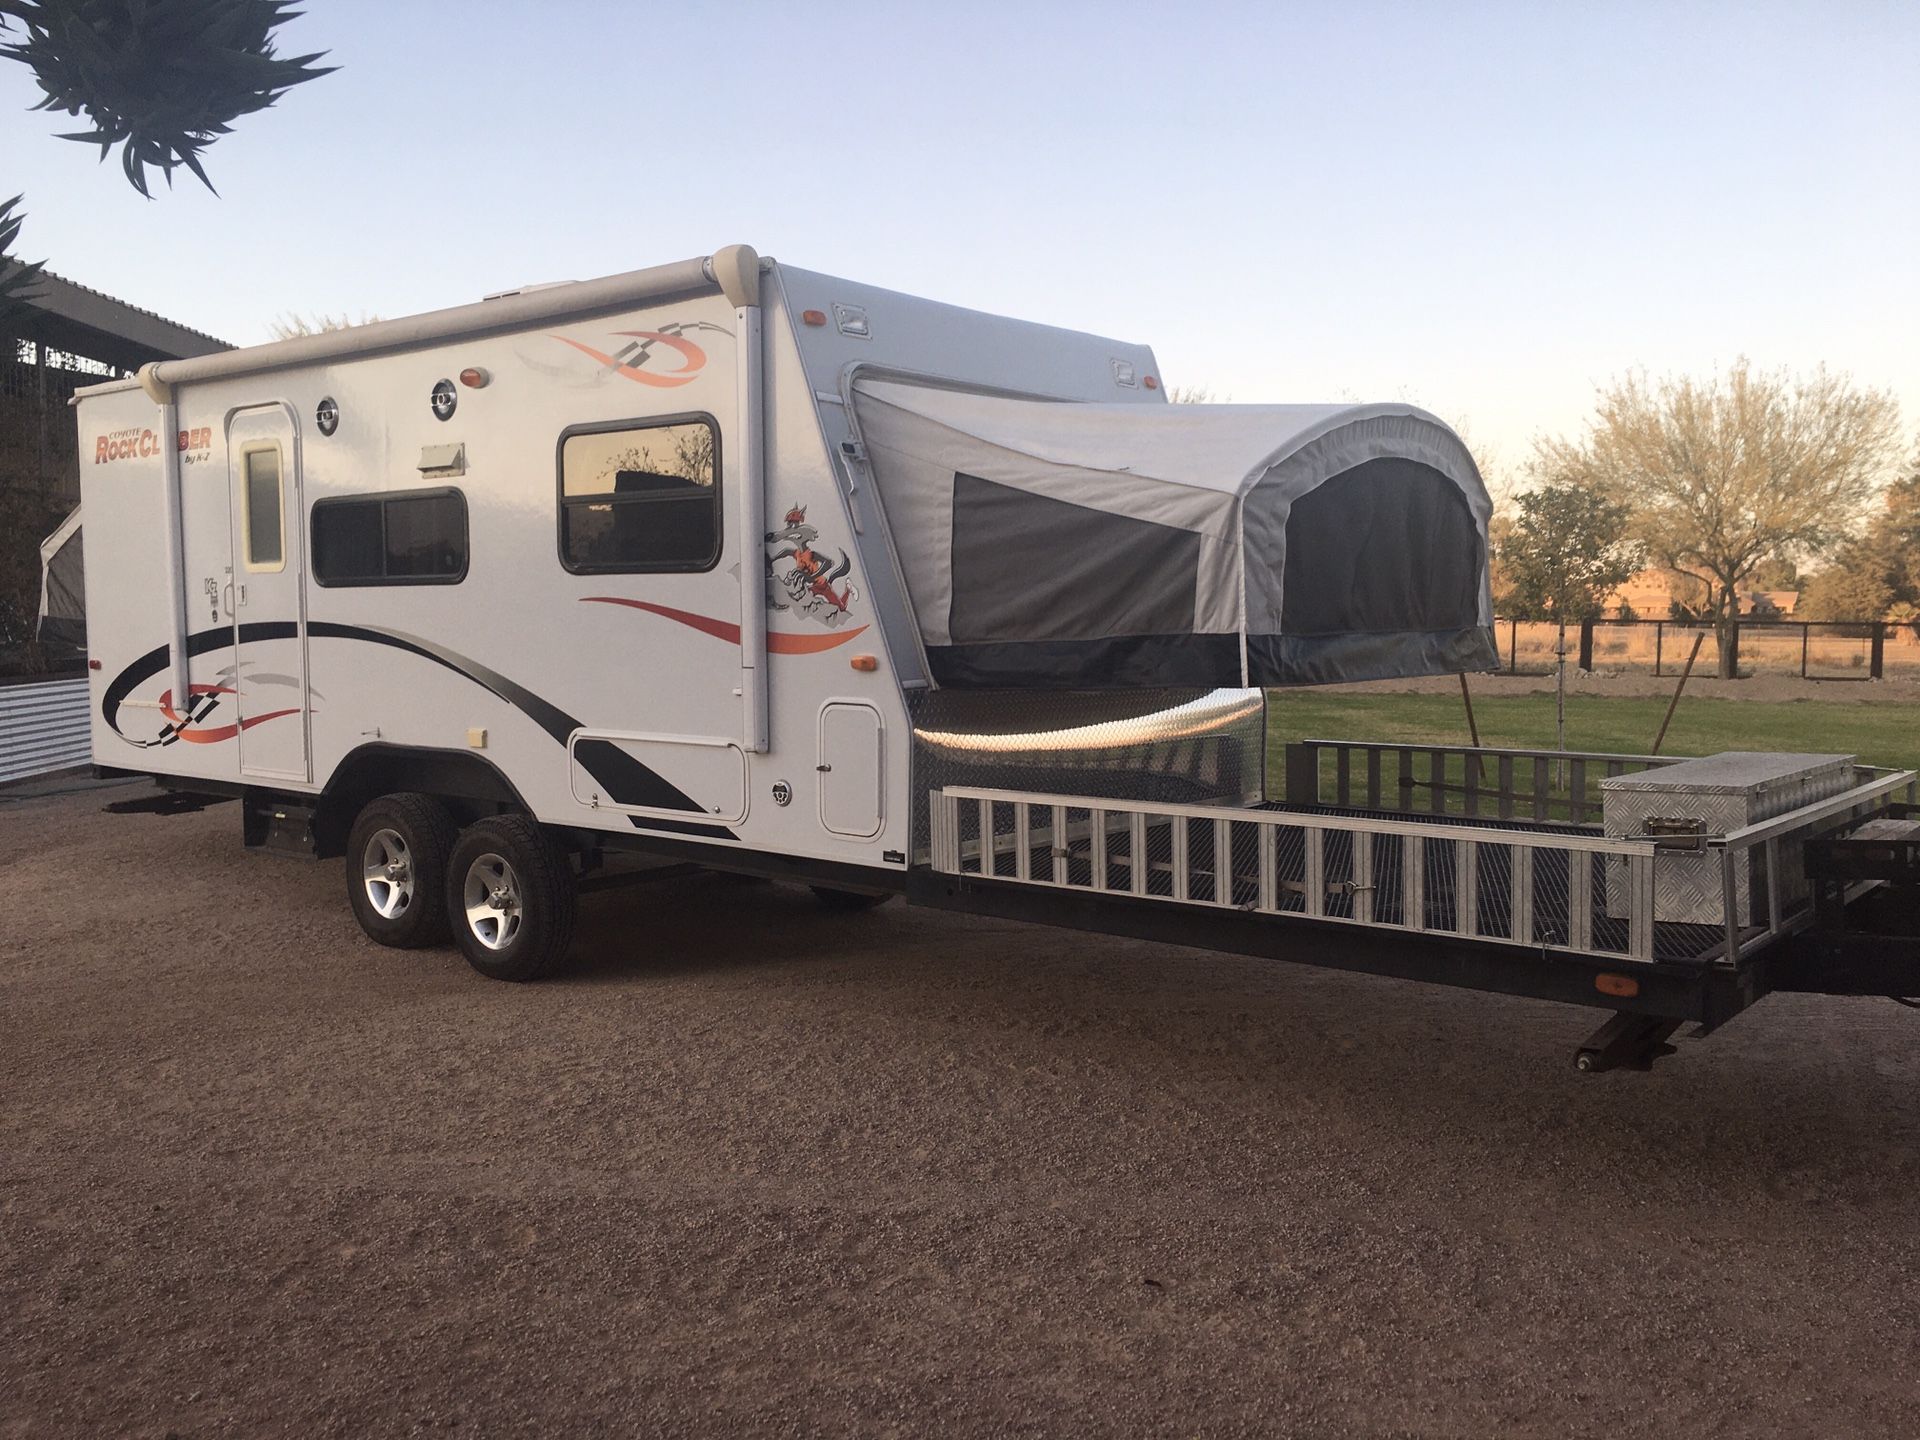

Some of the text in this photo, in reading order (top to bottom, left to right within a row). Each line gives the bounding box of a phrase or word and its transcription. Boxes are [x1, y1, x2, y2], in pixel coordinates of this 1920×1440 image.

[109, 428, 141, 440] COYOTE
[140, 428, 211, 458] CLBER
[184, 455, 196, 465] by
